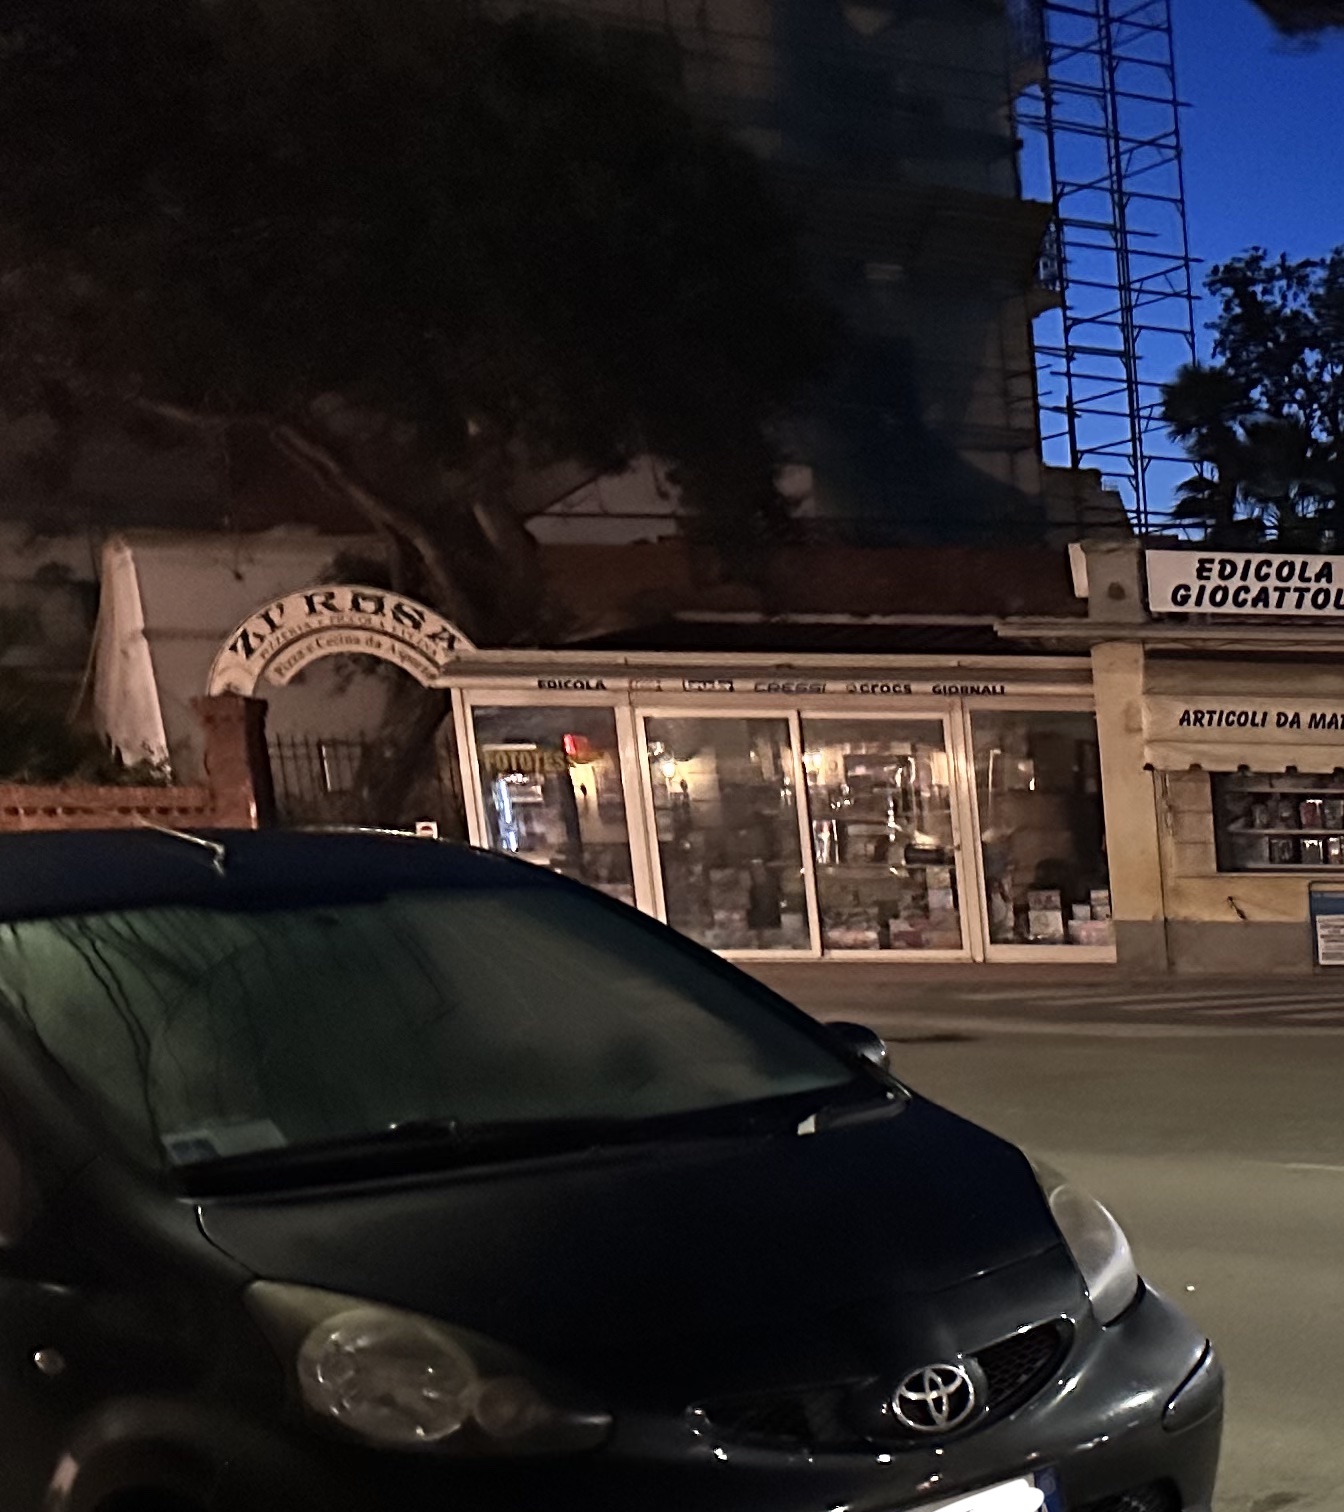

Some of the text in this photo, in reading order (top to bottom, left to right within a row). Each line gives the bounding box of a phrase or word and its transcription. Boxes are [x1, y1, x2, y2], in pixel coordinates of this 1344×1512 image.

[1196, 558, 1333, 584] EDICOLA
[304, 591, 461, 650] ROSA
[538, 679, 607, 690] EDICOLA
[932, 684, 1006, 695] GIORNALI
[1179, 709, 1268, 728] ARTICOLI
[1275, 711, 1301, 729] DA
